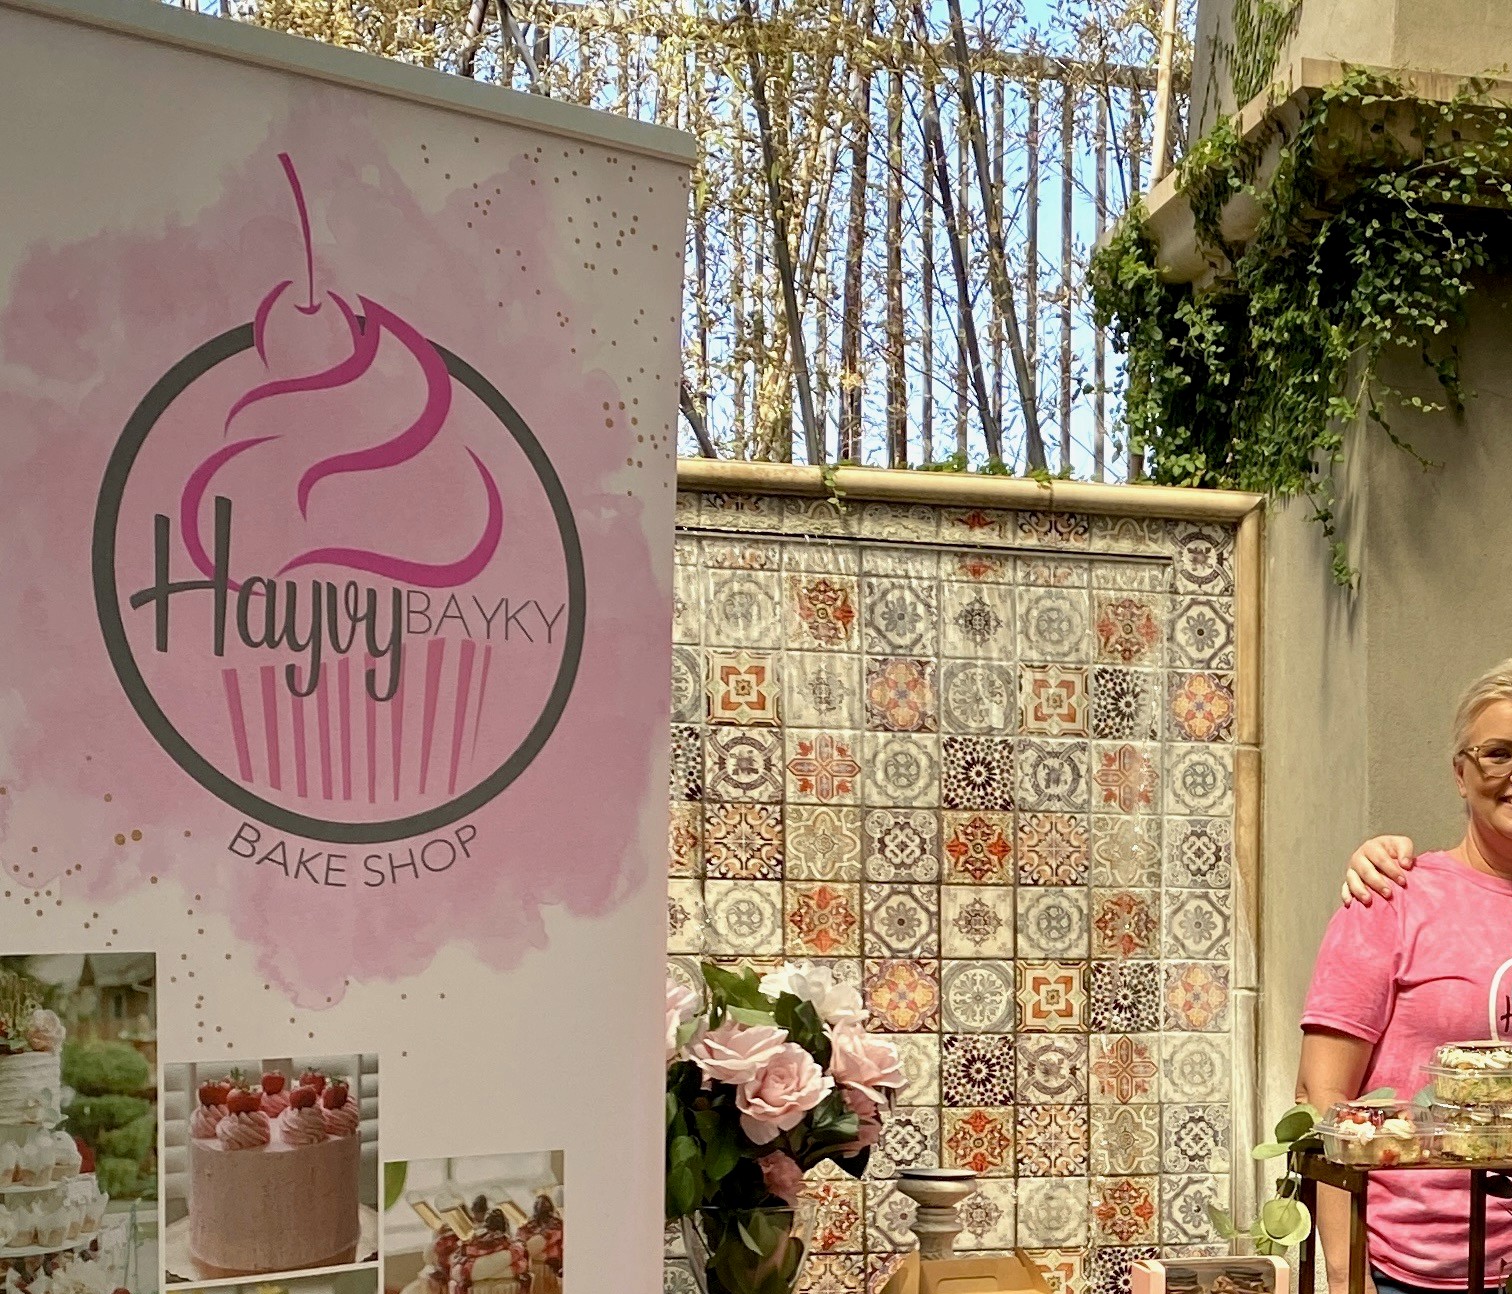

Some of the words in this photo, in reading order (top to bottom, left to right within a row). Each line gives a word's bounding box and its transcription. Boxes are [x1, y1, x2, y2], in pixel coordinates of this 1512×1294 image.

[130, 496, 404, 701] Hayvy
[406, 590, 565, 644] BAYKY
[227, 822, 348, 887] BAKE
[364, 824, 478, 887] SHOP
